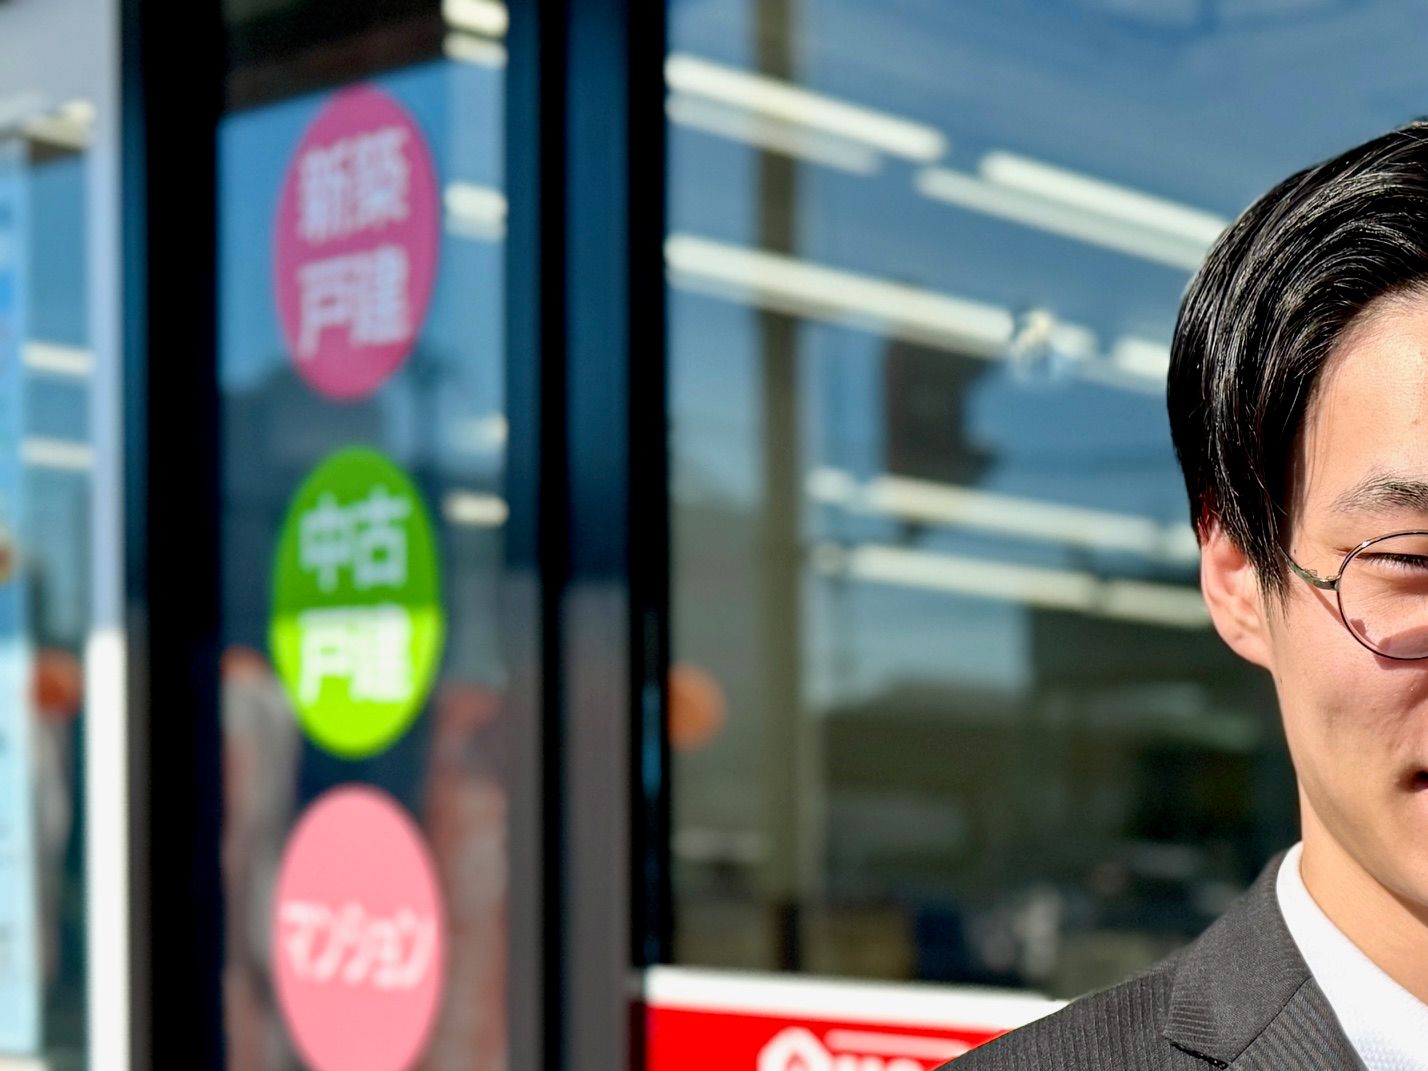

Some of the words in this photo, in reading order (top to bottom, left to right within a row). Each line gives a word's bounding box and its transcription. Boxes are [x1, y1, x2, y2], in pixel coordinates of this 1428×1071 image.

[298, 246, 409, 358] 戸建
[299, 487, 409, 592] 中古
[299, 602, 411, 706] 戸建
[281, 902, 438, 988] マンション
